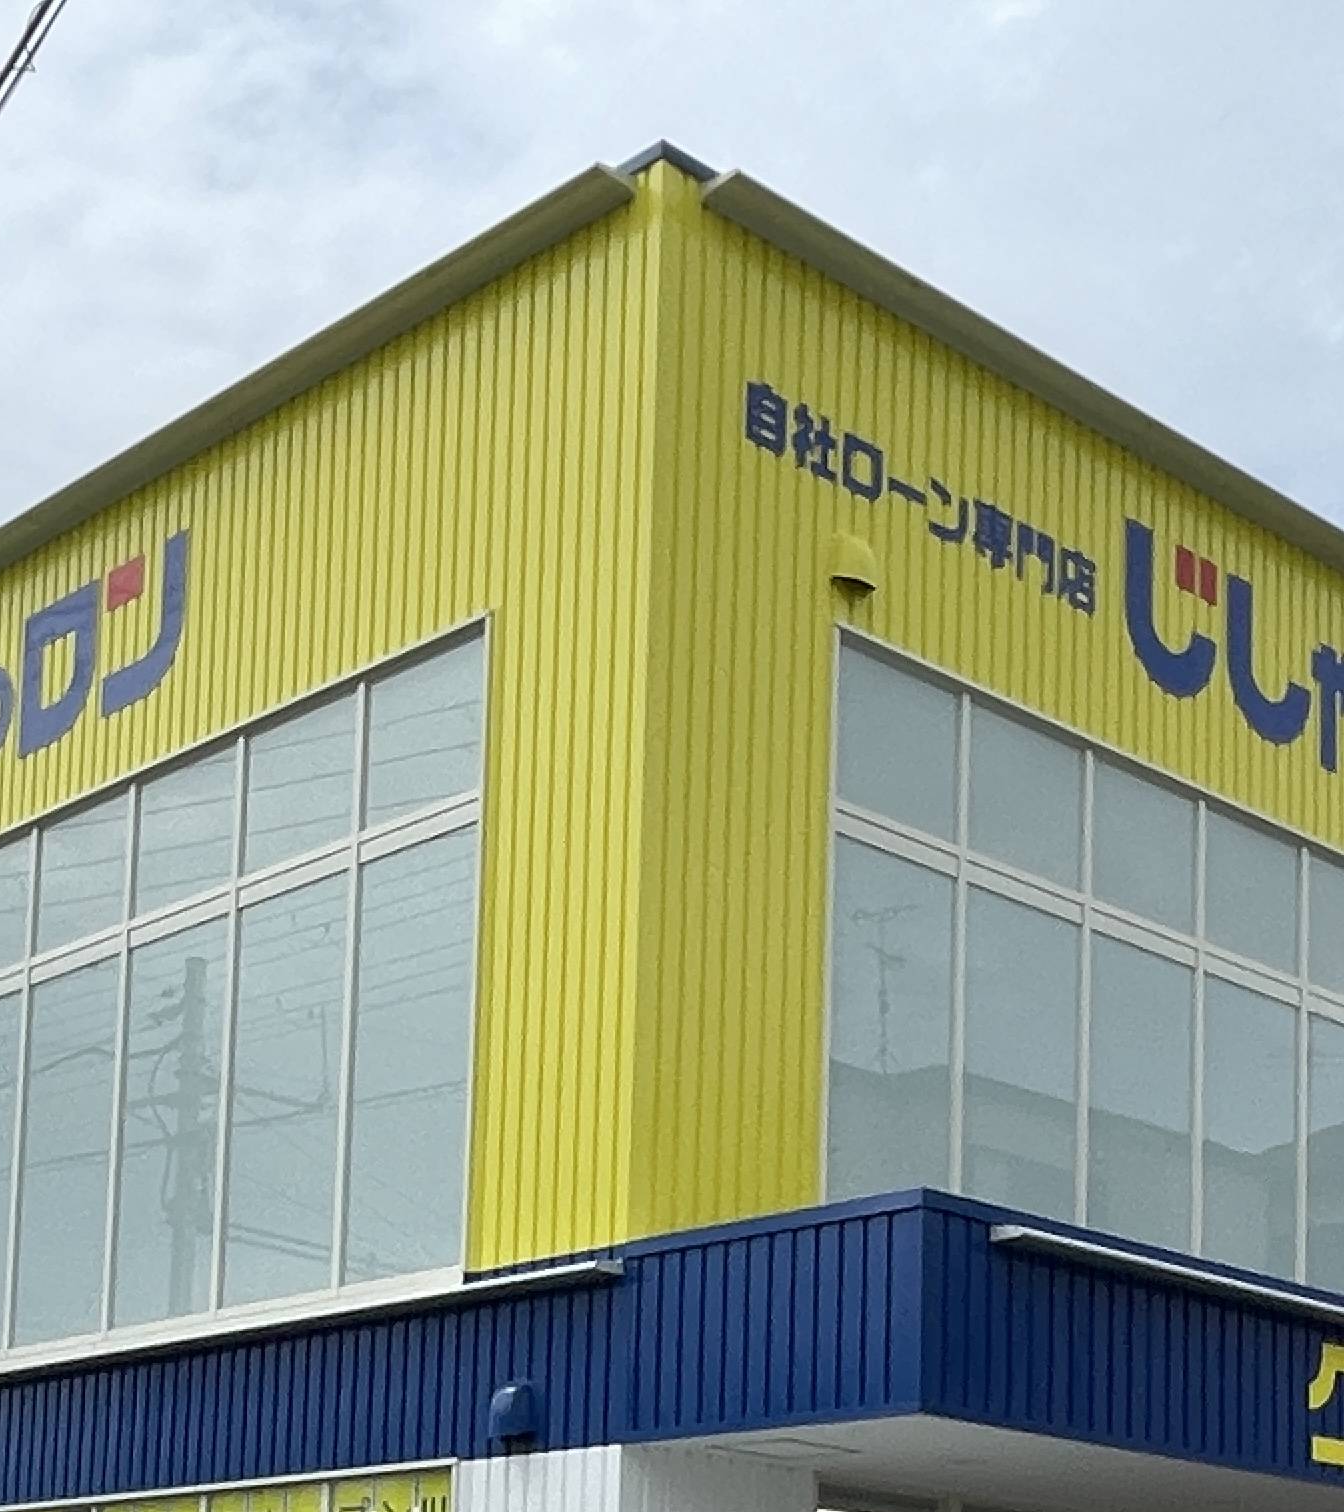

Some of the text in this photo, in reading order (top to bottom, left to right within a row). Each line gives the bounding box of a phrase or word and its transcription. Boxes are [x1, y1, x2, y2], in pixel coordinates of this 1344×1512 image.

[746, 381, 1096, 616] 自社ローン専門店
